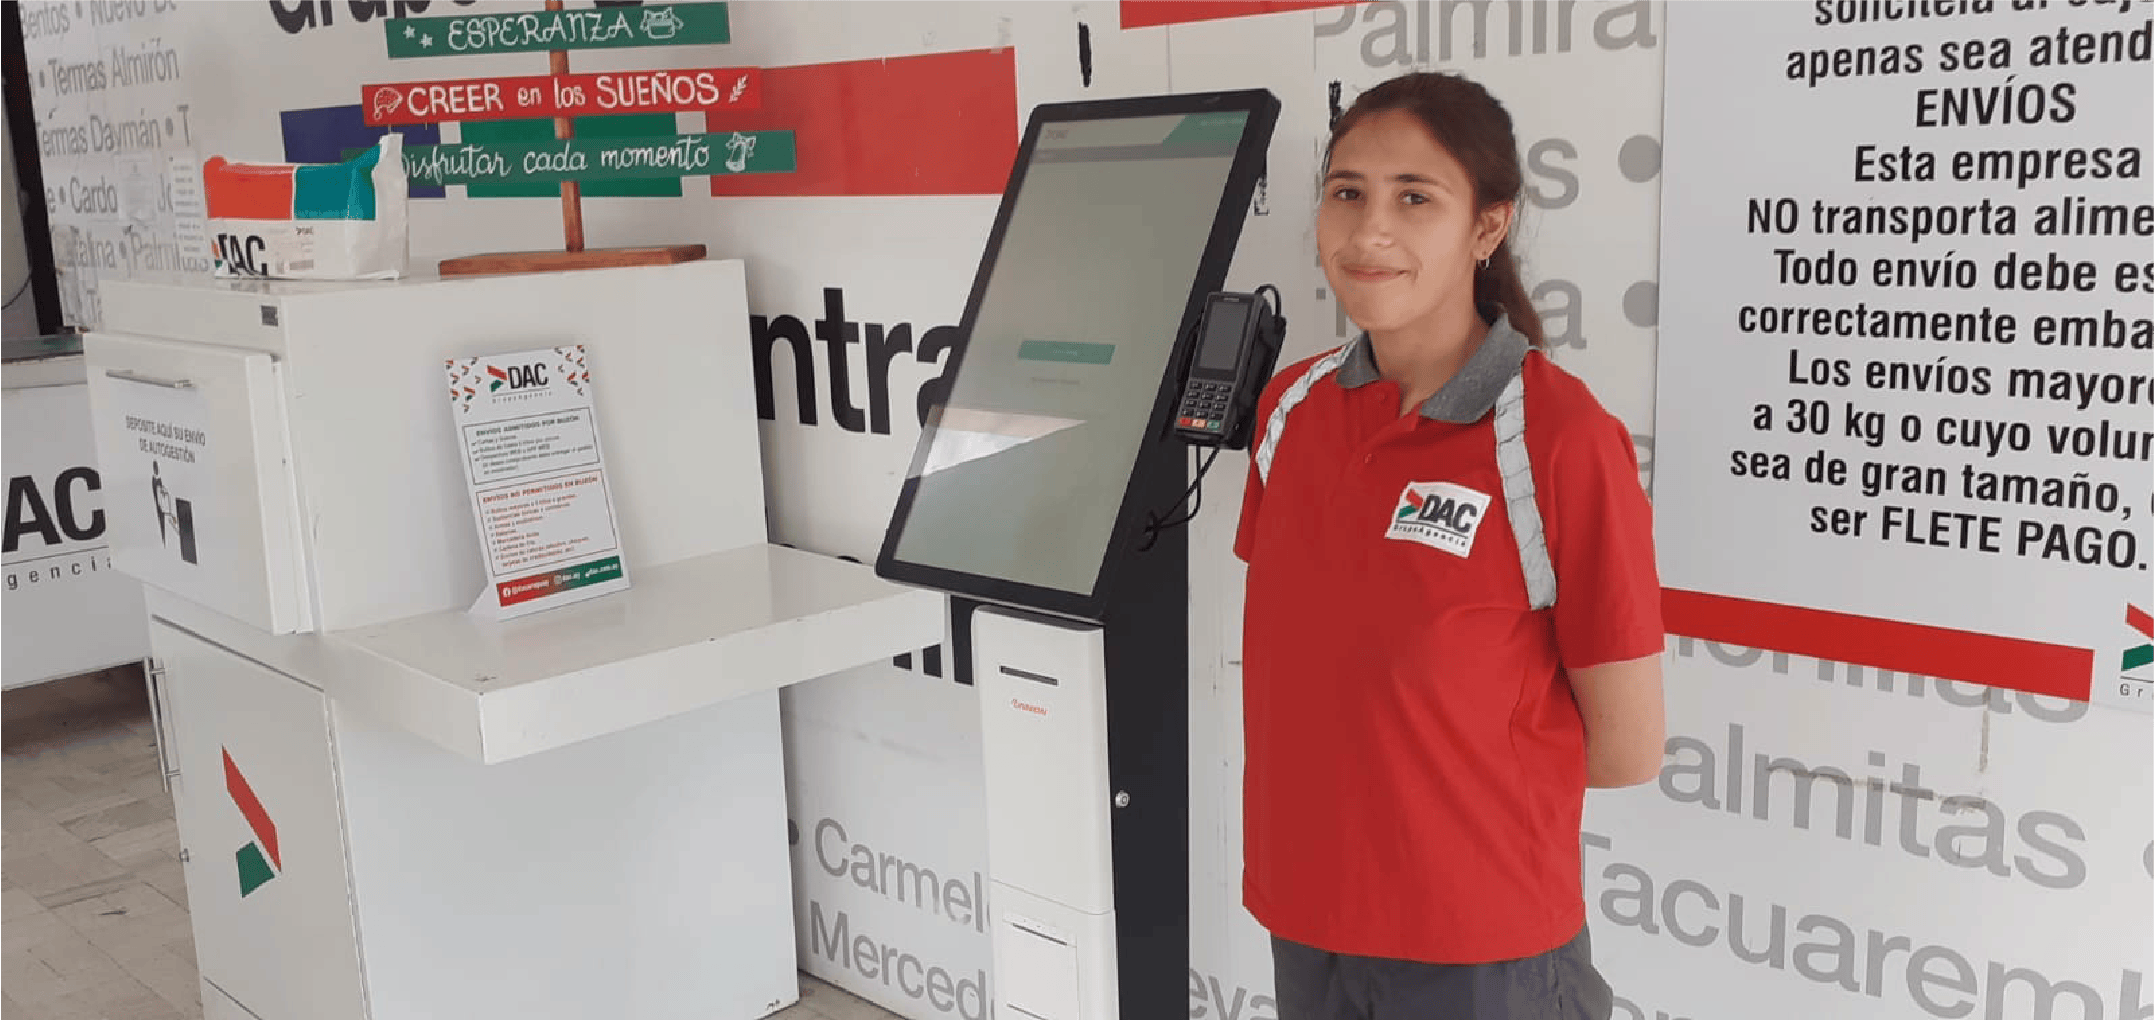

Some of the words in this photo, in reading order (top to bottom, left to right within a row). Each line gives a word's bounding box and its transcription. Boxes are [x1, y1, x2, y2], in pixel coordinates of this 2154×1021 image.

[448, 11, 633, 50] ESPERANZA
[48, 58, 107, 96] Termas
[112, 38, 180, 88] Almirón
[1787, 44, 1923, 87] apenas
[1939, 37, 2011, 73] sea
[406, 83, 503, 117] CREER
[517, 87, 542, 109] en
[554, 78, 587, 109] los
[596, 72, 720, 110] SUEÑOS
[1916, 75, 2077, 128] ENVÍOS
[90, 108, 162, 152] Daymán
[523, 139, 589, 174] cada
[601, 134, 711, 171] momento
[1854, 145, 1935, 183] Esta
[1952, 147, 2141, 190] empresa
[1748, 197, 1798, 234] NO
[1812, 199, 2017, 243] transporta
[1773, 248, 1857, 287] Todo
[1872, 250, 1977, 289] envío
[1993, 251, 2097, 292] debe
[1738, 302, 2016, 345] correctamente
[507, 362, 549, 389] DAC
[1789, 348, 1851, 388] Los
[1865, 355, 1992, 396] envíos
[1753, 403, 1773, 432] a
[1785, 398, 1830, 436] 30
[1845, 402, 1886, 447] kg
[1900, 414, 1922, 443] o
[1936, 417, 2031, 458] cuyo
[1730, 450, 1791, 480] sea
[1804, 449, 1847, 486] de
[1861, 463, 1946, 498] gran
[1961, 464, 2131, 519] tamaño,
[3, 466, 107, 553] AC
[1417, 494, 1478, 533] DAC
[1810, 505, 1868, 537] ser
[1881, 505, 2001, 553] FLETE
[2017, 520, 2147, 571] PAGO.
[815, 818, 991, 933] Carmel
[810, 900, 995, 1020] Merced
